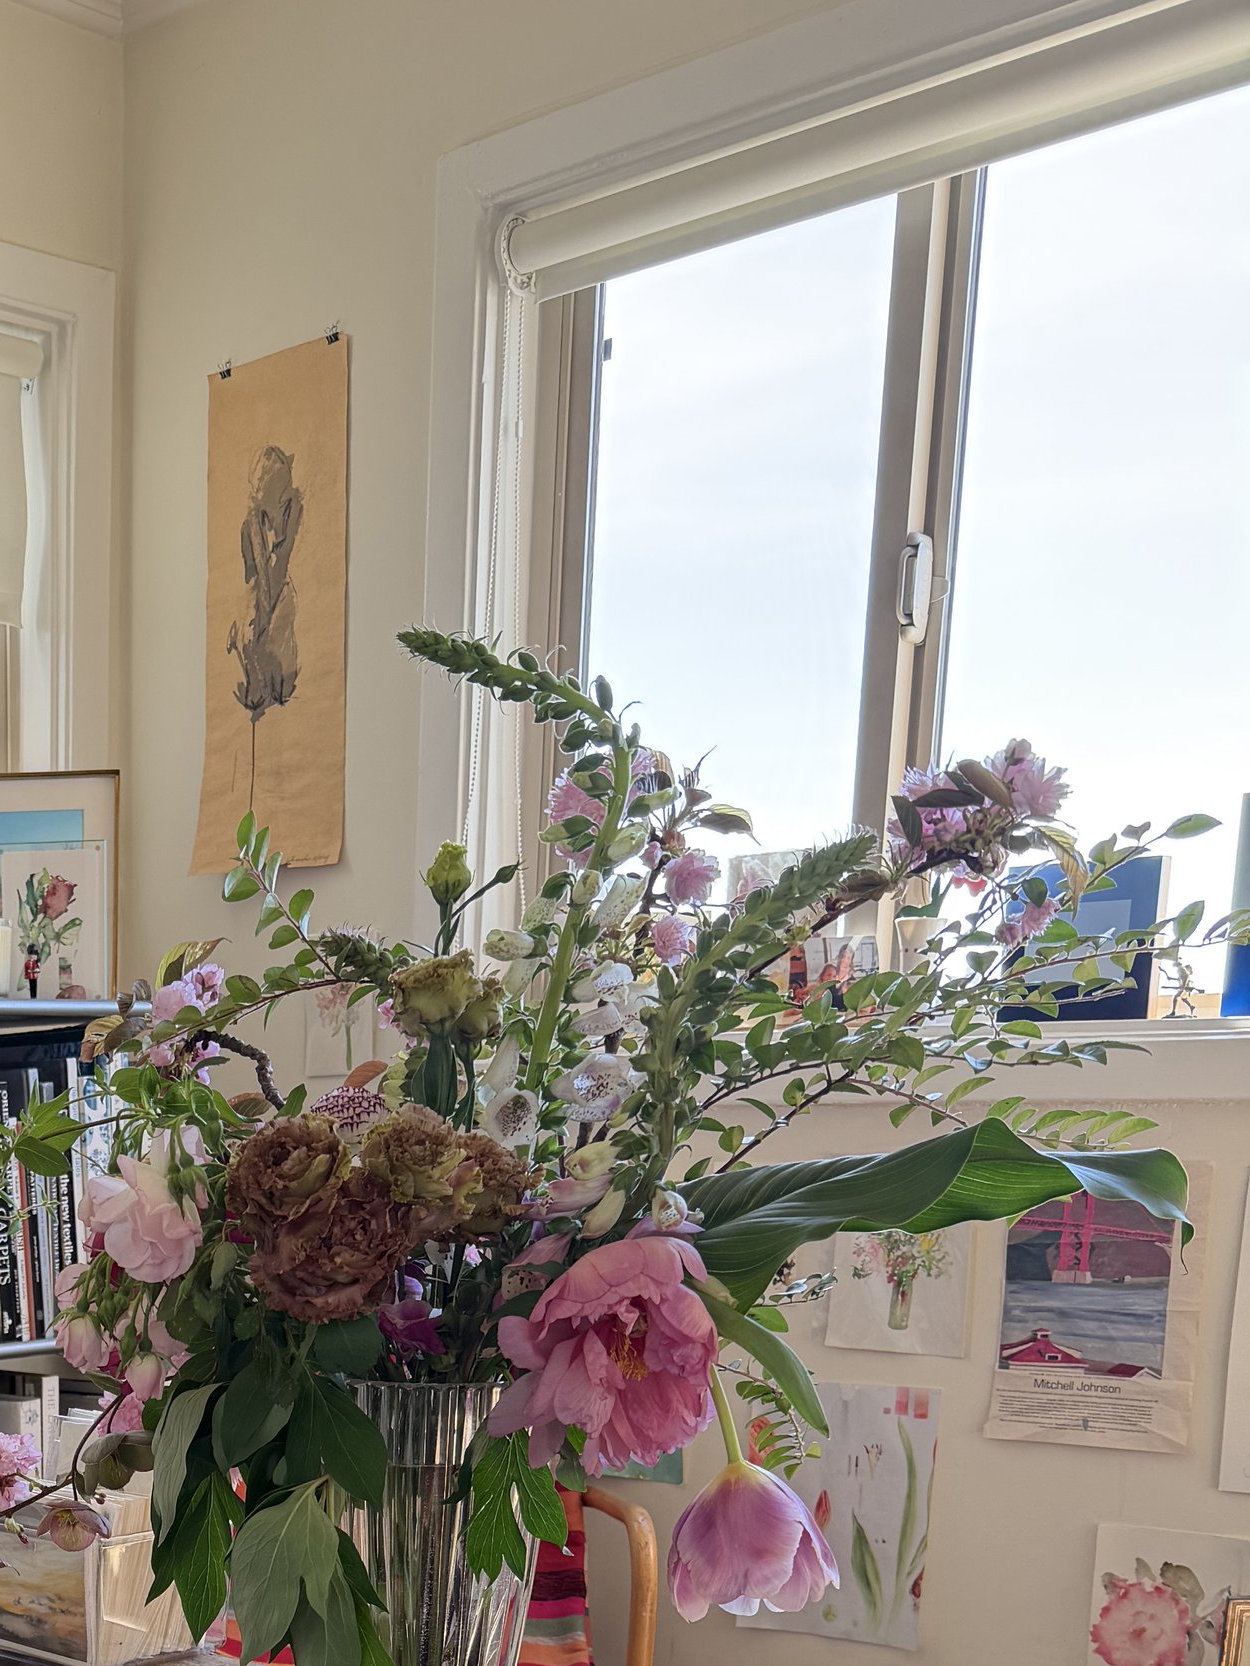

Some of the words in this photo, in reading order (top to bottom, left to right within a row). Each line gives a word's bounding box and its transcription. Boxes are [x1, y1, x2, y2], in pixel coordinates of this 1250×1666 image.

[60, 1174, 70, 1193] the
[61, 1196, 70, 1220] new
[62, 1223, 73, 1265] textiles
[1034, 1378, 1074, 1391] Mitchell
[1076, 1382, 1121, 1394] Johnson
